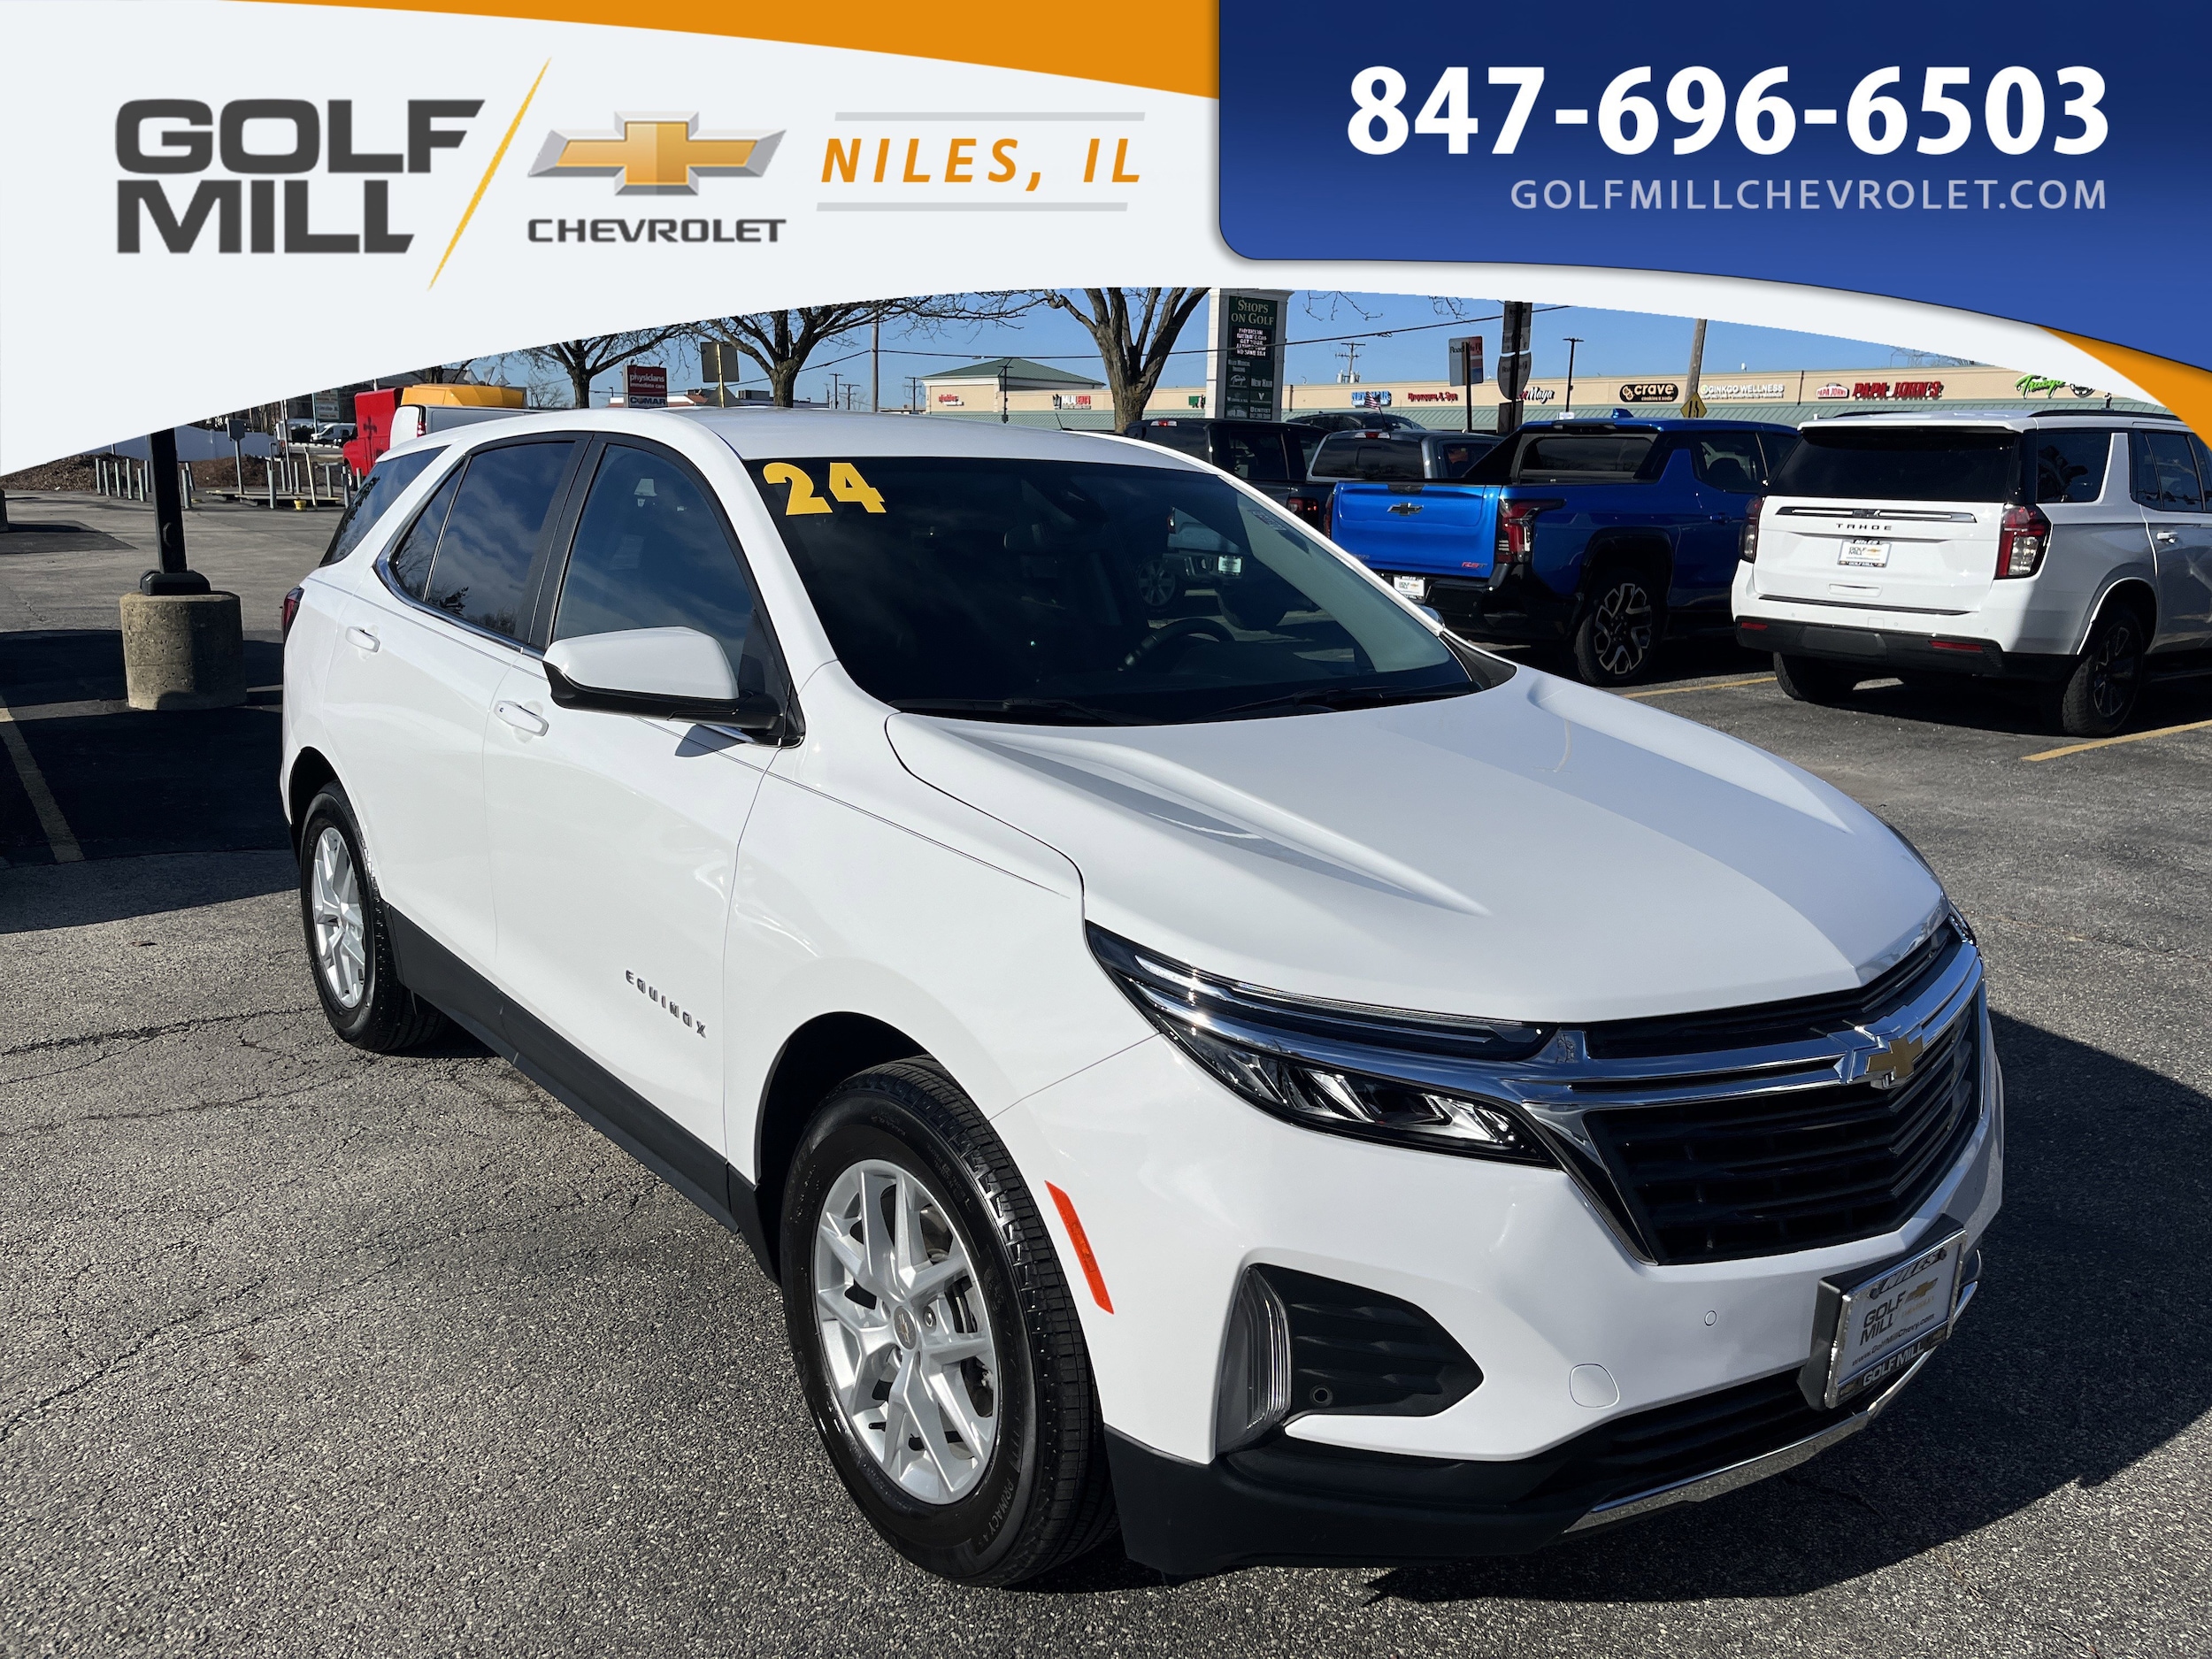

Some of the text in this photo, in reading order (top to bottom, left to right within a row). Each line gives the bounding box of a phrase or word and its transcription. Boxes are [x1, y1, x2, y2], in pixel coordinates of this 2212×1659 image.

[629, 373, 664, 382] physicians
[1633, 384, 1674, 396] crave
[1708, 384, 1785, 396] GINKGO WELLNESS
[1851, 380, 1943, 400] PAPA JOHN'S
[762, 462, 887, 516] 24
[626, 969, 707, 1039] EQUINOX
[1863, 1290, 1907, 1329] GOLF
[1859, 1313, 1893, 1347] MILL
[1862, 1341, 1925, 1387] GOLF MILL
